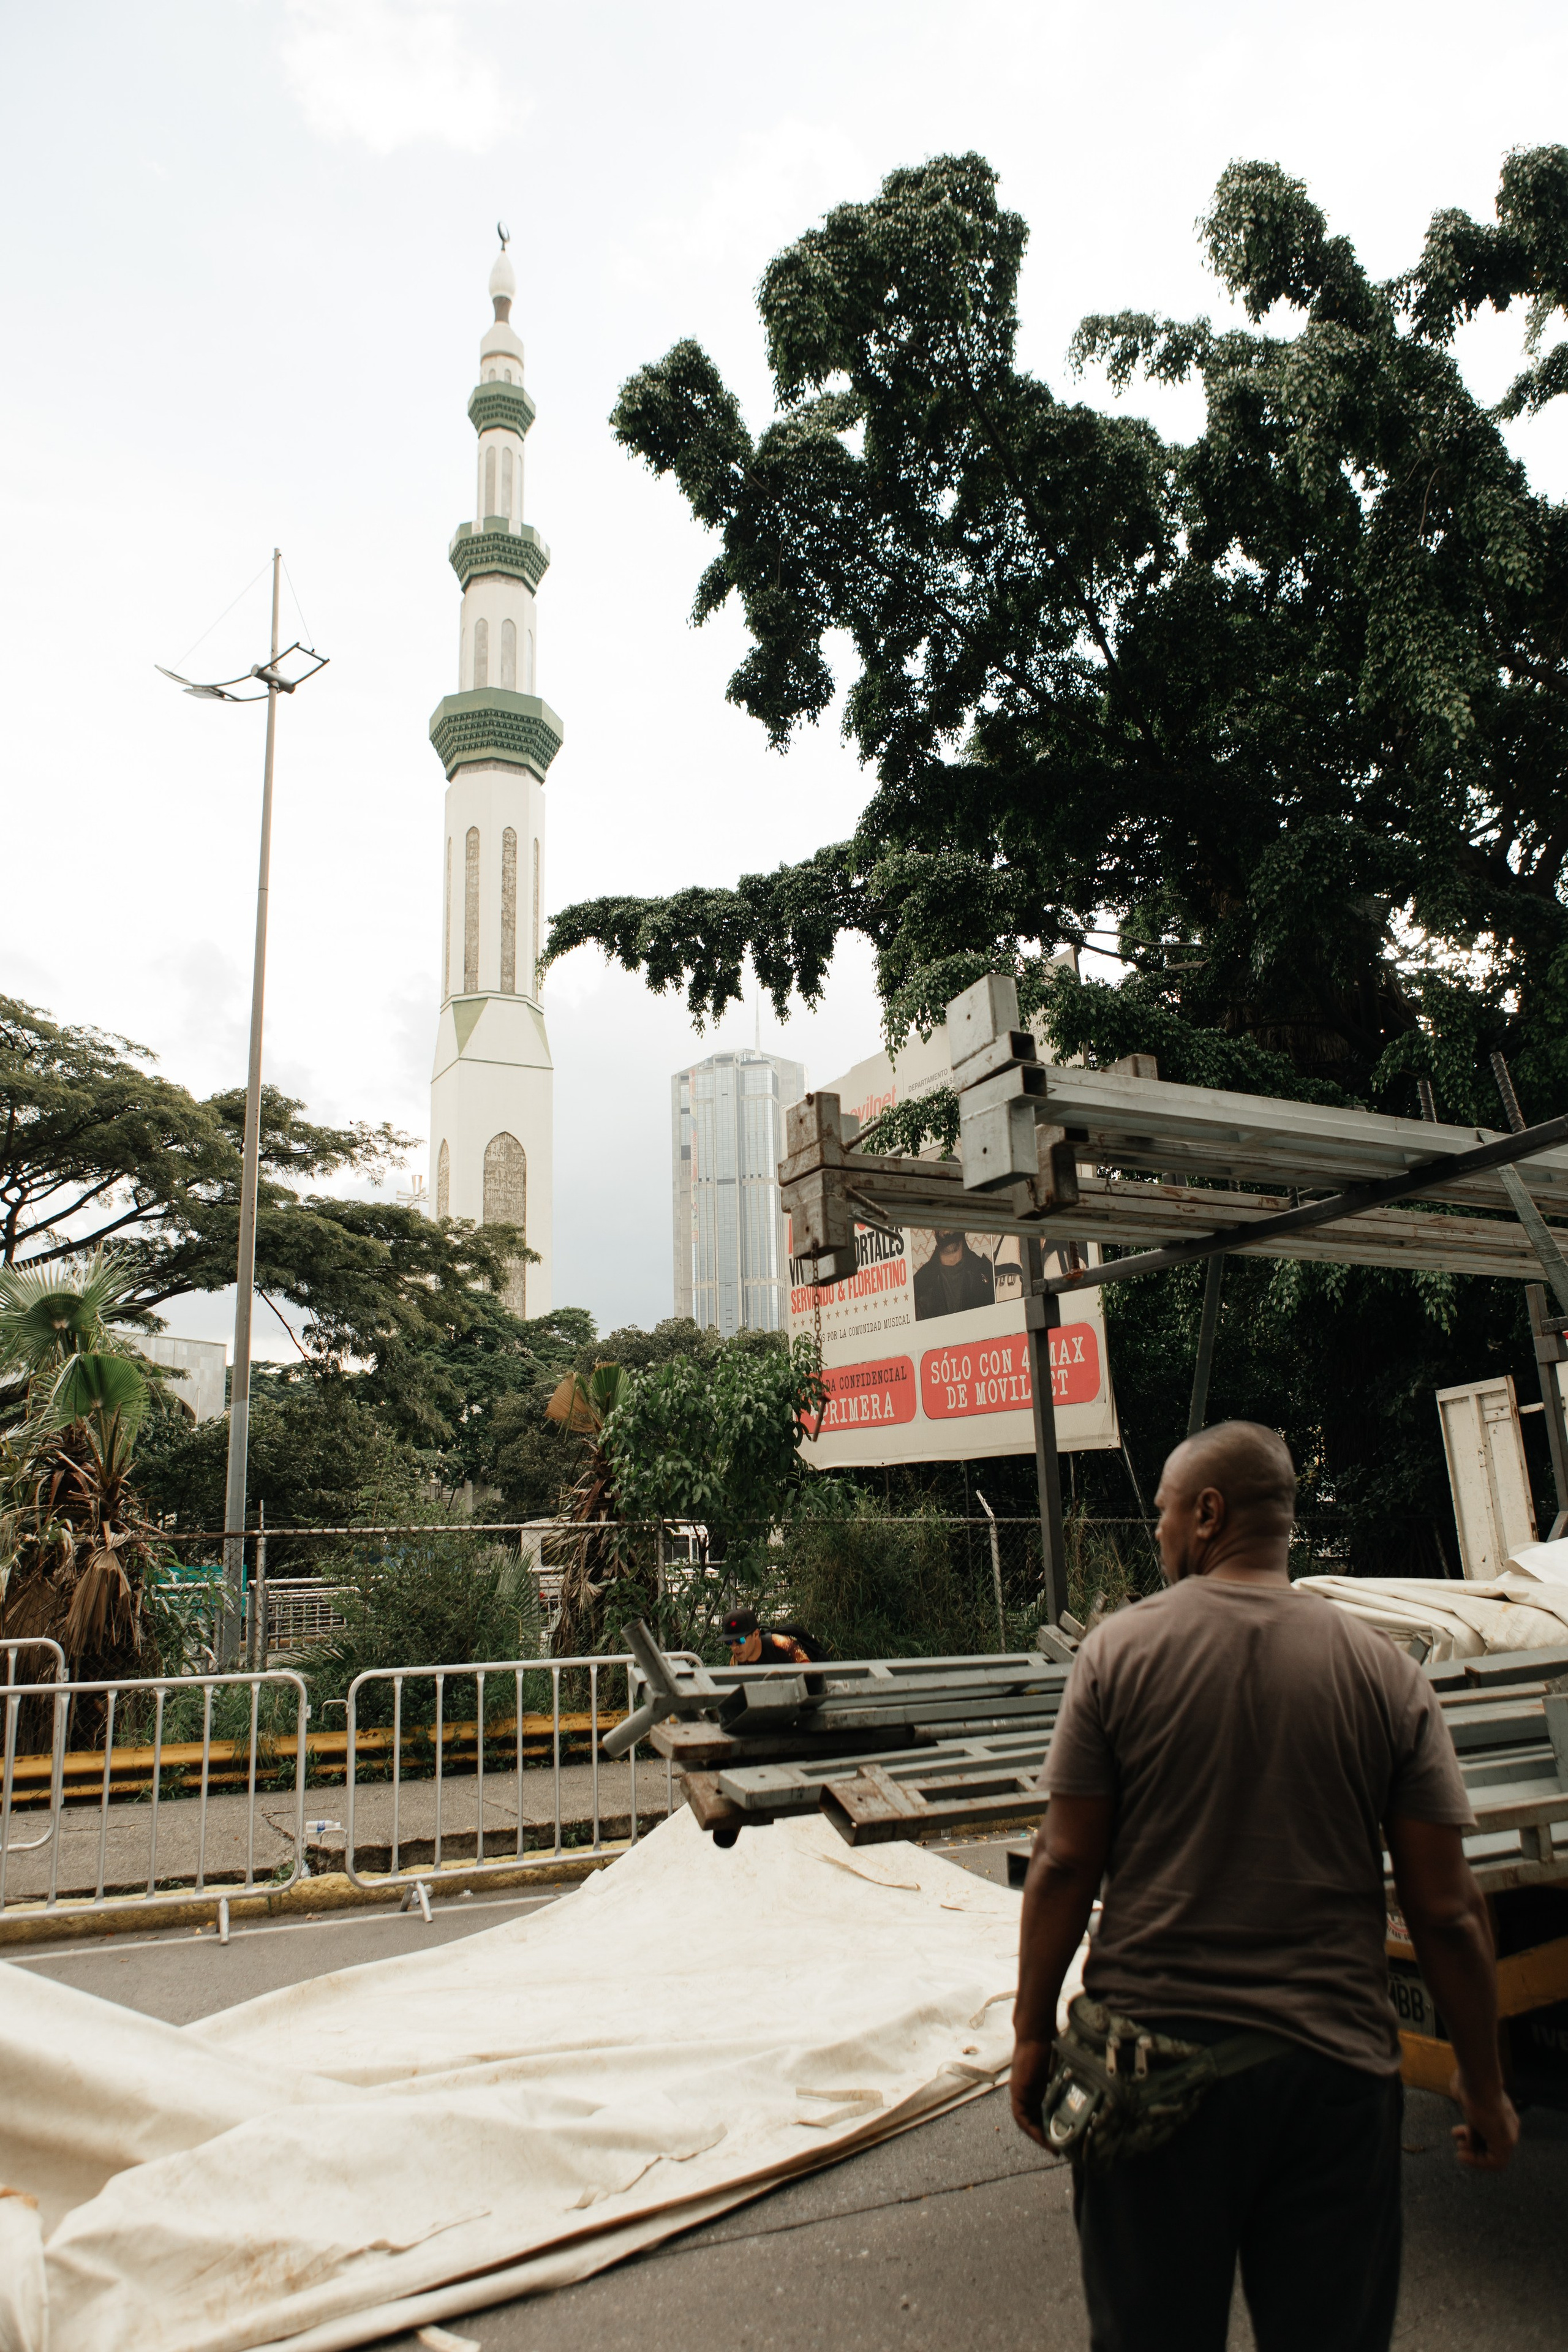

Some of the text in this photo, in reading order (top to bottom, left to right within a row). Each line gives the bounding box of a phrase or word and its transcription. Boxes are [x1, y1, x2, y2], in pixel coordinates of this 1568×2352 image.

[908, 1068, 948, 1093] DEPARTAMENTO
[940, 1077, 954, 1087] SALS
[837, 1280, 846, 1302] &
[848, 1258, 907, 1300] FLORENTINO
[827, 1331, 837, 1341] POR
[839, 1328, 846, 1339] LA
[848, 1321, 881, 1336] COMUNIDAD
[884, 1314, 911, 1329] MUSICAL
[839, 1365, 907, 1390] CONFIDENCIAL
[930, 1352, 971, 1384] SÓLO
[979, 1348, 1012, 1377] CON
[946, 1384, 968, 1409] DE
